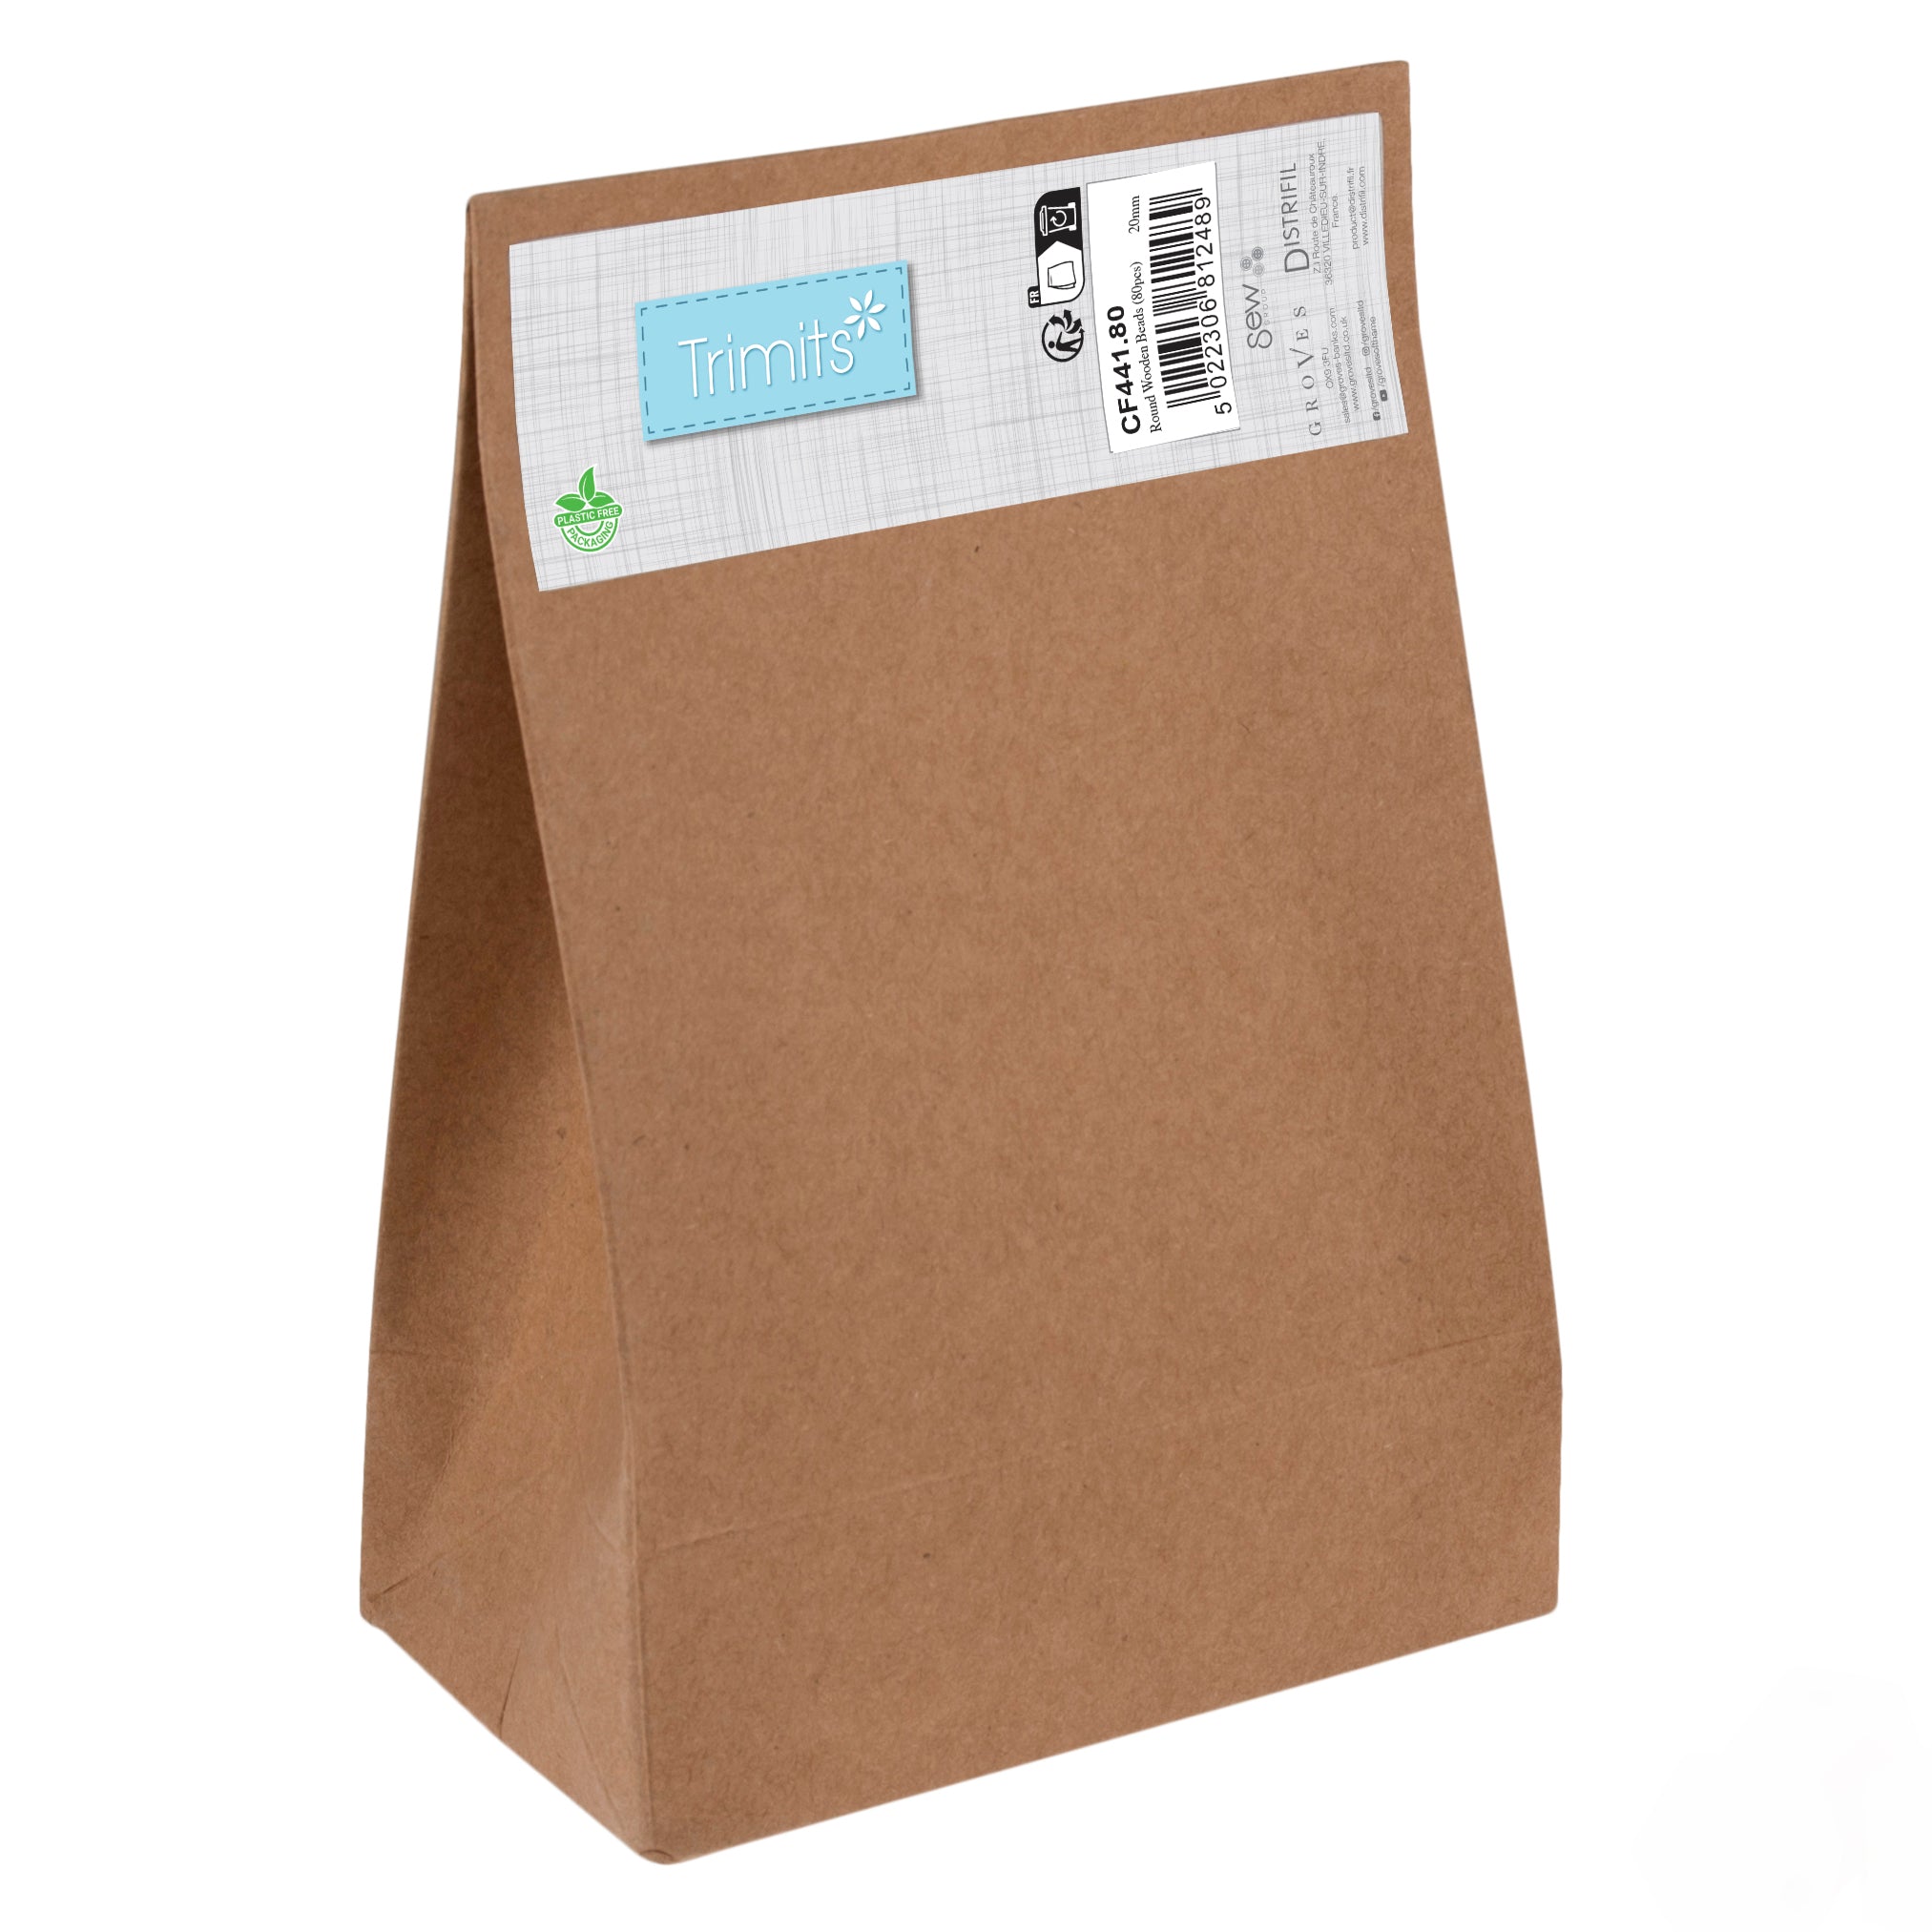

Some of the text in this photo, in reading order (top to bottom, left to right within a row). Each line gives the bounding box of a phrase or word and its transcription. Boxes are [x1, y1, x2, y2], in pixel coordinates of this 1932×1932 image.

[1279, 162, 1310, 273] DISTRIFIL
[1310, 216, 1318, 228] de
[1311, 230, 1319, 259] Route
[1359, 166, 1369, 245] www.distrifil.com
[1029, 290, 1040, 303] FR
[1129, 195, 1162, 433] Round Wooden Beads (80pcs) 20mm
[1195, 197, 1233, 414] 5 022306 812489
[1242, 283, 1273, 349] Sew
[1261, 289, 1271, 325] GROUP
[677, 319, 855, 398] Trimits
[1107, 305, 1141, 434] CF441.80
[1289, 306, 1322, 436] GROVES
[1321, 347, 1334, 388] OX9 3FU
[1329, 308, 1350, 424] sales@groves-banks.com
[1340, 316, 1360, 411] www.grovesltd.co.uk
[557, 507, 620, 526] PLASTIC FREE
[567, 520, 613, 547] PACKAGING
